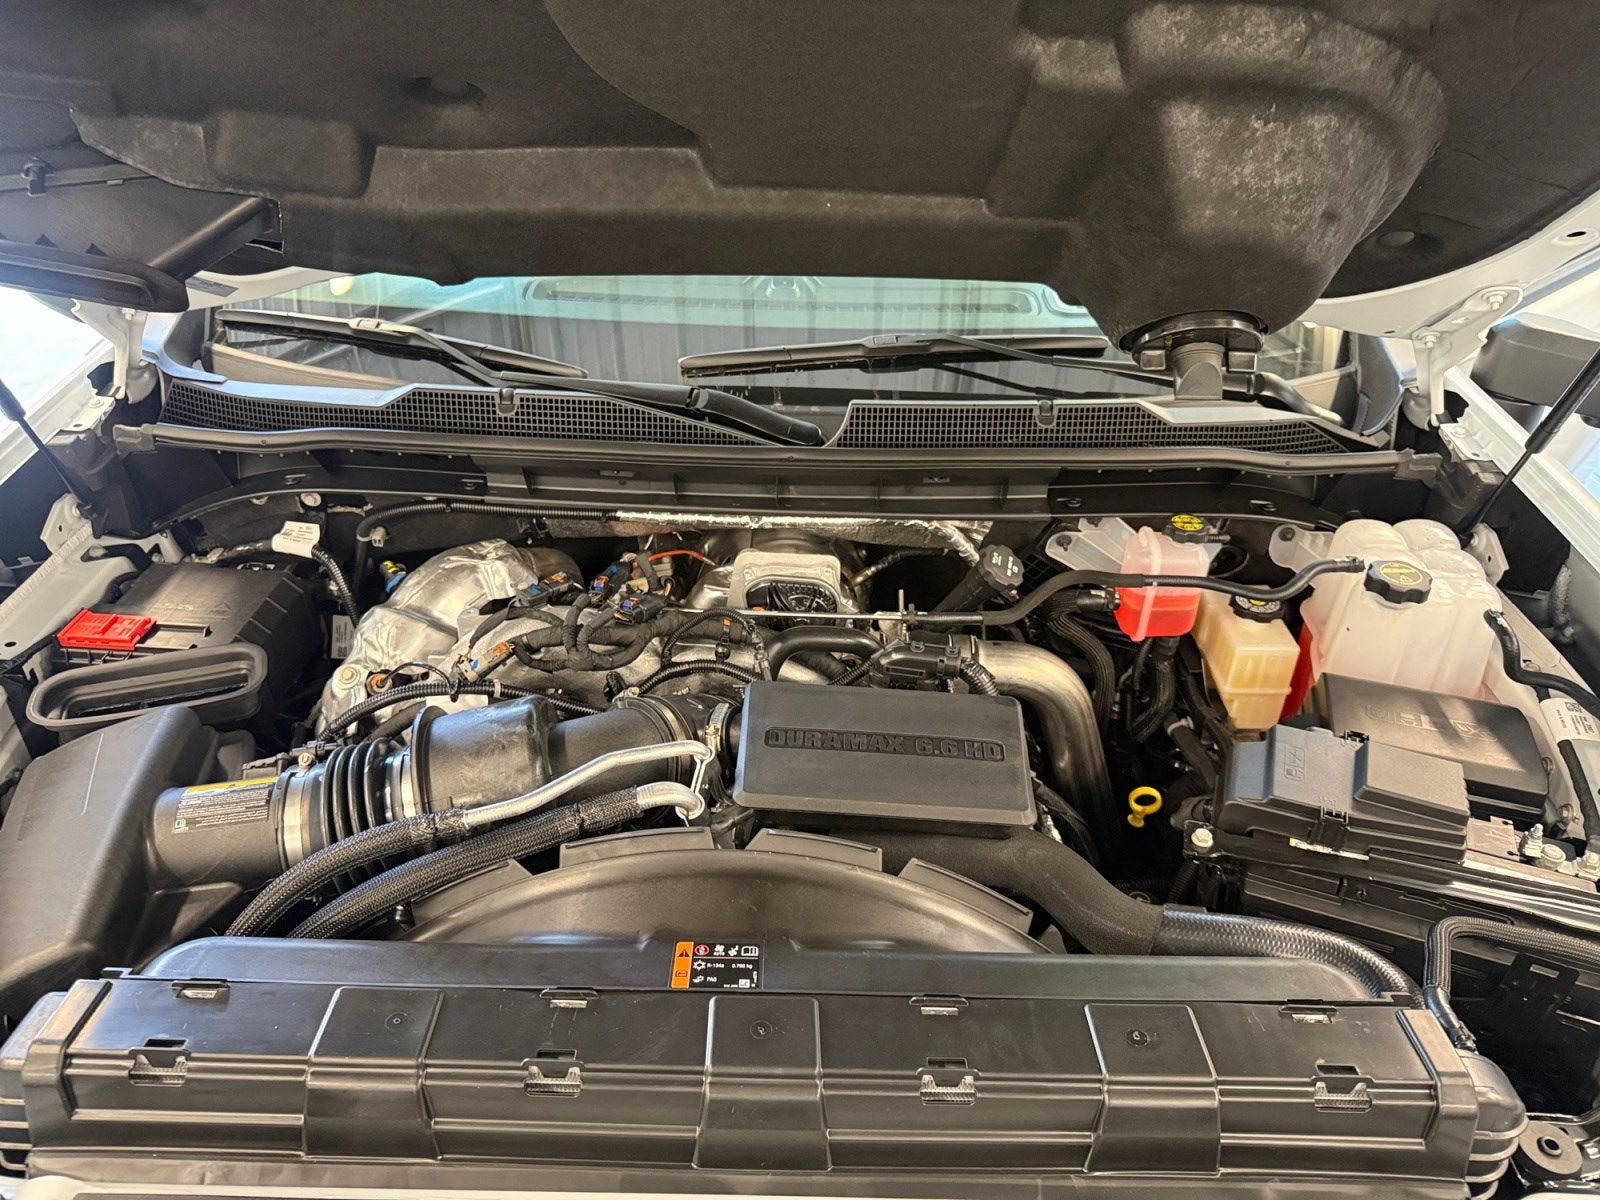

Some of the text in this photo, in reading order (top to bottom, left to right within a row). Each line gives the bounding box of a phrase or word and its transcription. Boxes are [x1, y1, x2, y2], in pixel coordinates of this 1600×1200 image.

[769, 729, 1002, 760] DURAMAX 6.6 HD
